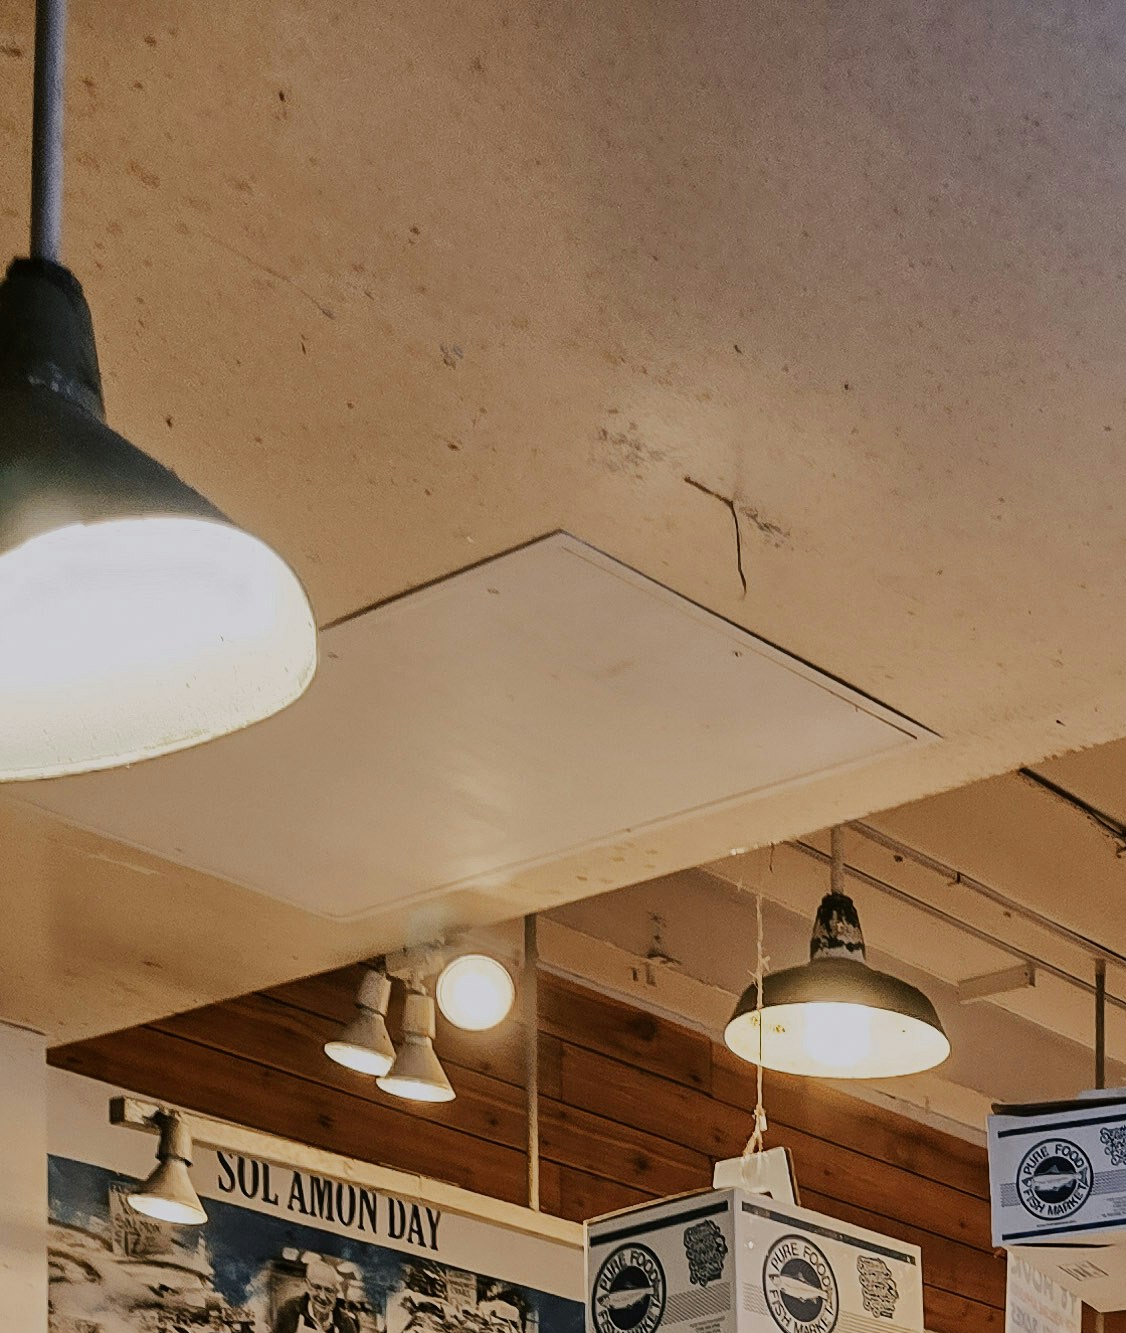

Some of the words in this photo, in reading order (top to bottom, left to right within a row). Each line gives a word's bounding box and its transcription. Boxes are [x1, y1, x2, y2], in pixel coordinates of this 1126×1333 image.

[1023, 1145, 1049, 1175] PURE
[1054, 1143, 1085, 1169] FOOD
[217, 1151, 278, 1206] SOL
[287, 1171, 377, 1234] AMON
[388, 1197, 441, 1251] DAY
[1022, 1188, 1045, 1213] FISH
[1047, 1183, 1088, 1216] MARKET
[600, 1252, 627, 1292] PURE
[630, 1251, 661, 1285] FOOD
[771, 1242, 800, 1272] PURE
[803, 1245, 831, 1287] FOOD
[769, 1289, 792, 1327] FISH
